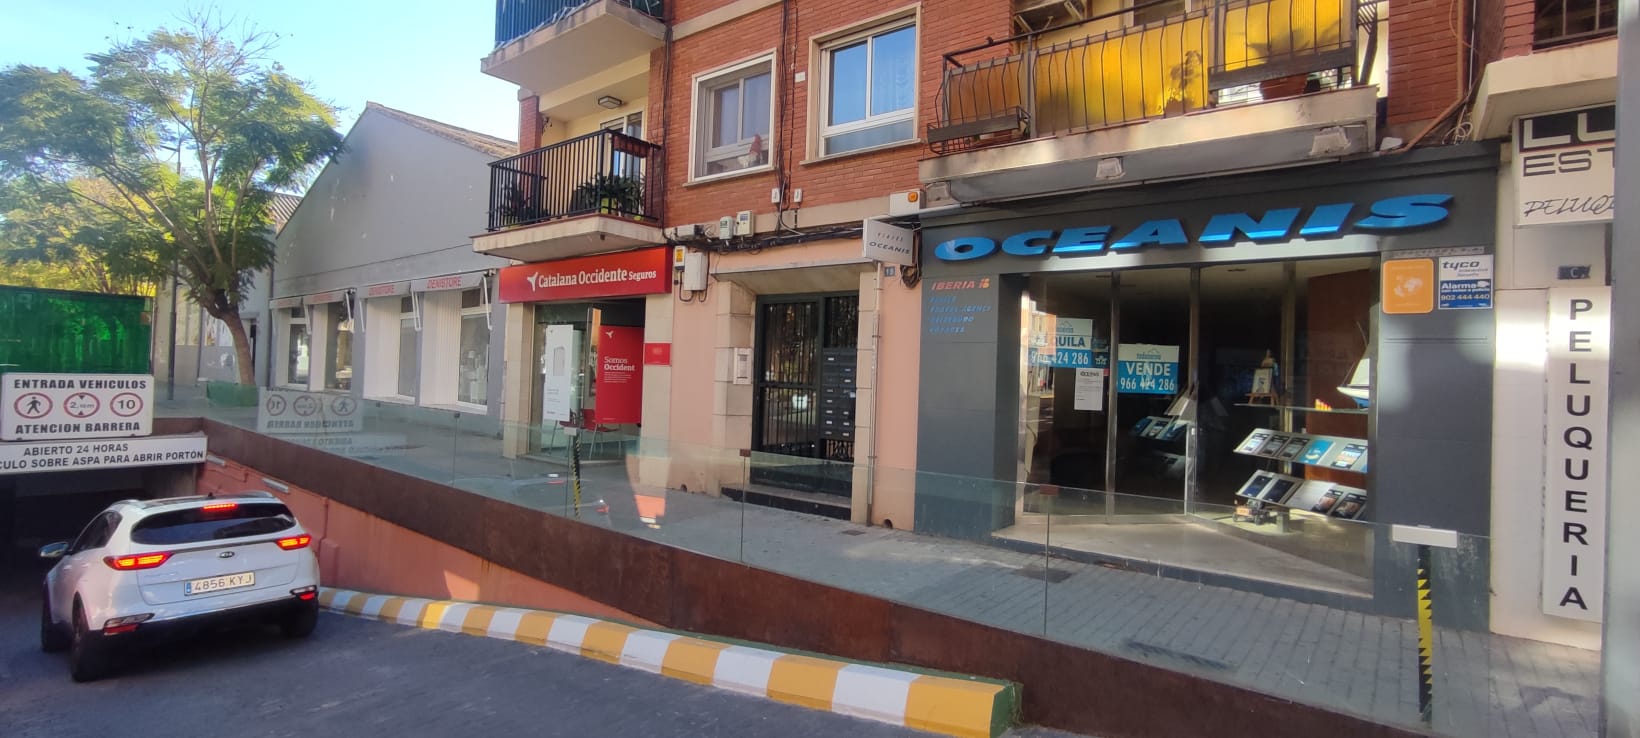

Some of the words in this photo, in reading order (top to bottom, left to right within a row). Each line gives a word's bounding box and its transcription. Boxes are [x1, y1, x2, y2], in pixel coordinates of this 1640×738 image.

[933, 193, 1454, 262] OCEANIS
[868, 241, 911, 255] OCEANIS
[1442, 260, 1480, 271] tyco
[538, 272, 577, 288] Catalana
[578, 267, 628, 285] Occidente
[628, 270, 657, 282] Seguros
[931, 280, 976, 291] IBERIA
[1441, 281, 1477, 290] Alarma
[1071, 352, 1089, 365] 286
[603, 363, 635, 372] Occident
[1126, 361, 1171, 376] VENDE
[14, 379, 75, 389] ENTRADA
[79, 379, 147, 390] VEHICULOS
[1120, 377, 1137, 391] 966
[1158, 377, 1175, 391] 286
[117, 399, 136, 410] 10
[15, 424, 80, 434] ATENCION
[85, 422, 140, 432] BARRERA
[23, 445, 73, 456] ABIERTO
[76, 445, 89, 454] 24
[92, 443, 129, 454] HORAS
[1559, 299, 1593, 610] PELUQUERIA
[31, 457, 69, 469] SOBRE
[72, 456, 100, 466] ASPA
[103, 455, 130, 464] PARA
[133, 453, 163, 462] ABRIR
[194, 578, 225, 591] 4856
[229, 573, 252, 586] KYJ
